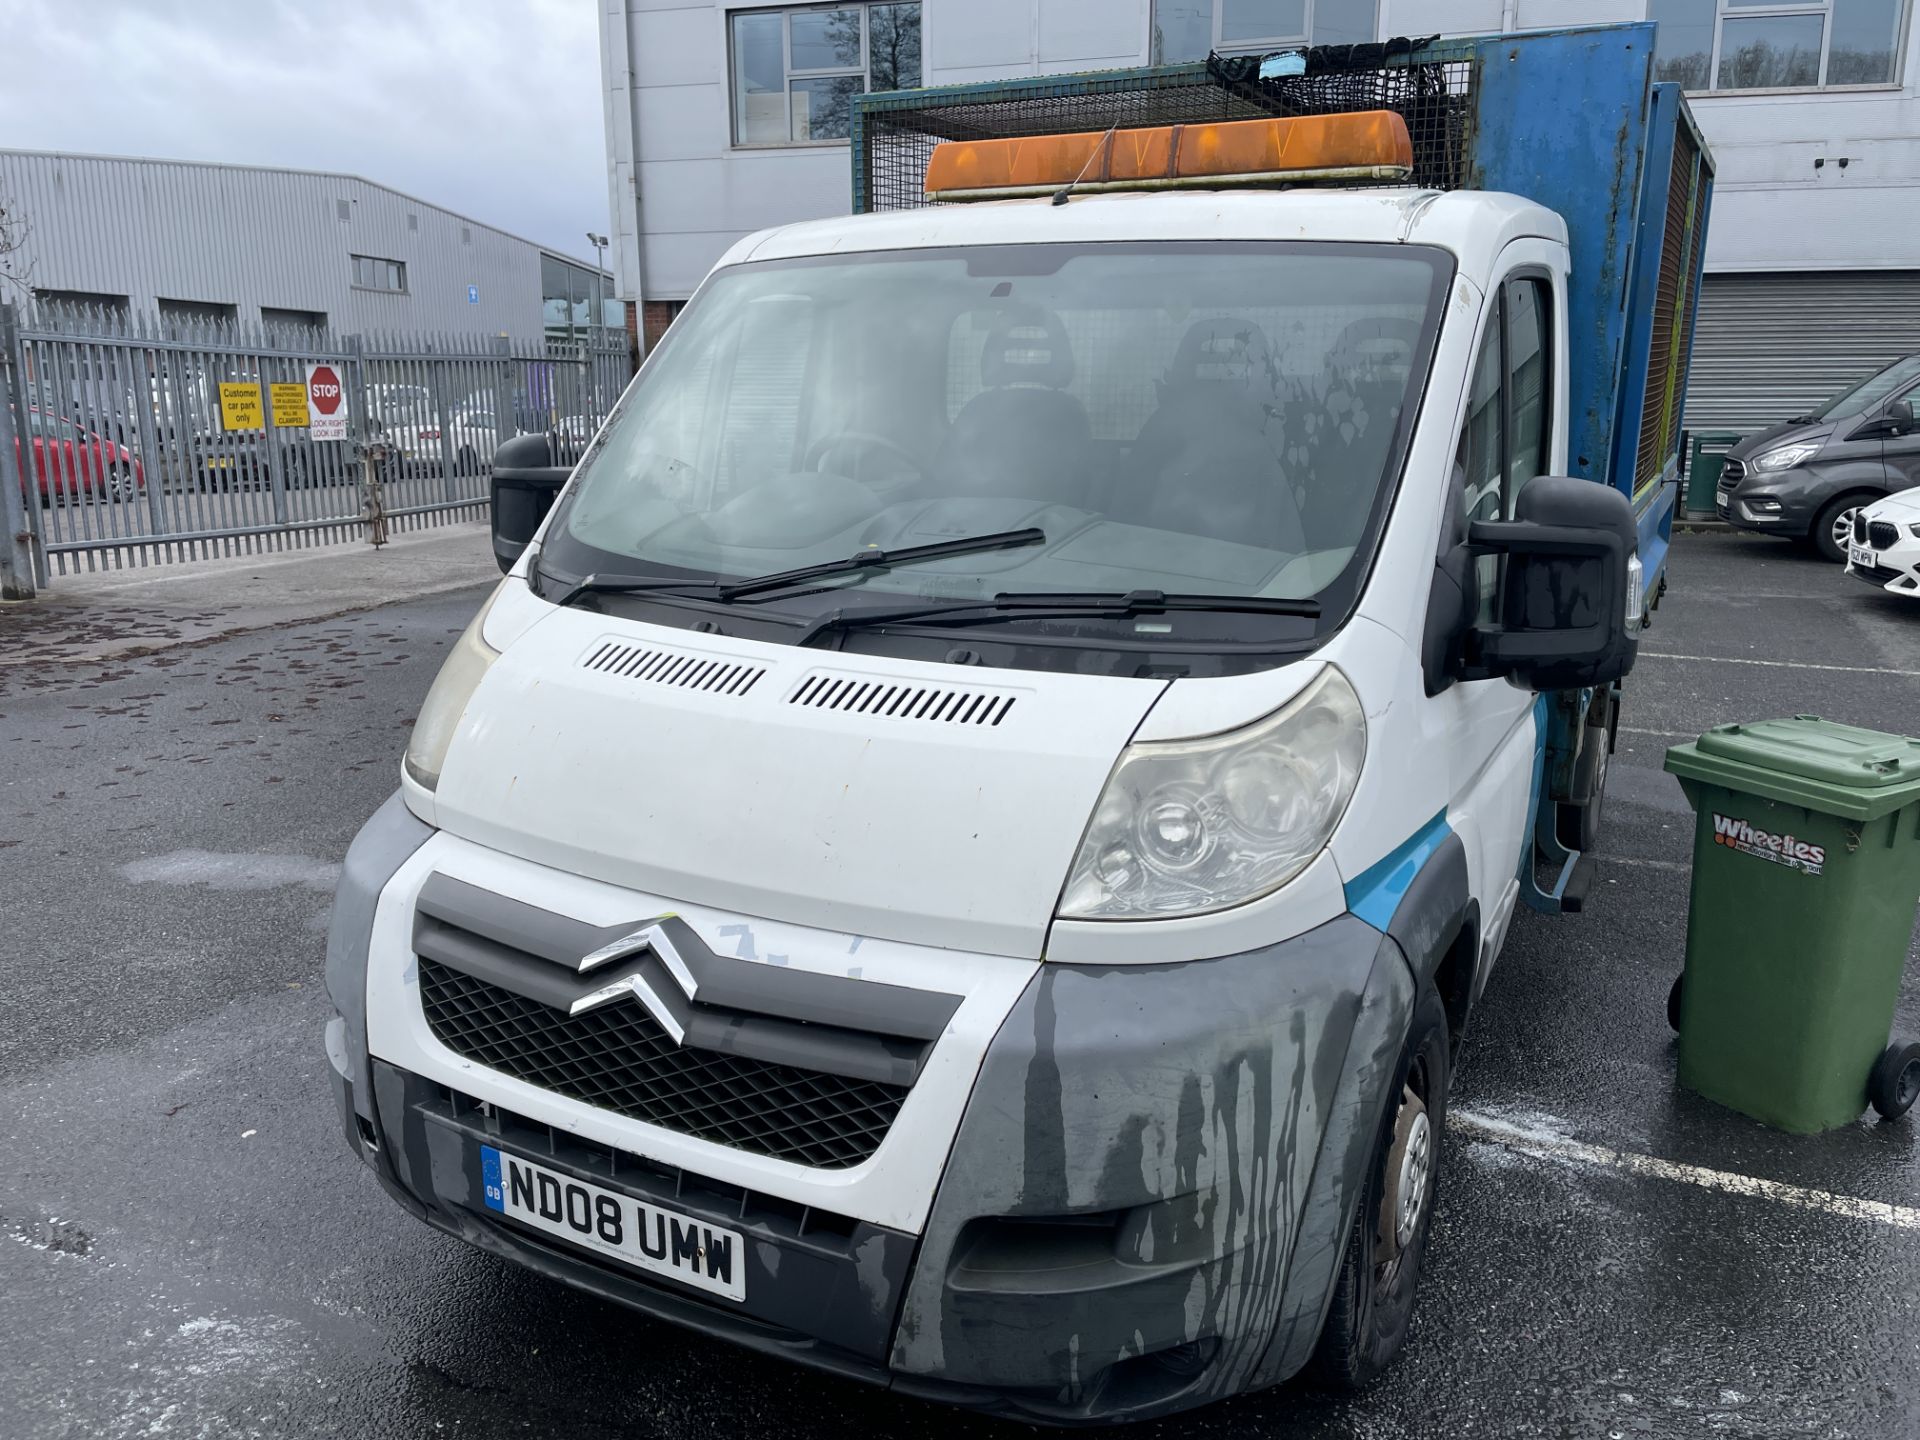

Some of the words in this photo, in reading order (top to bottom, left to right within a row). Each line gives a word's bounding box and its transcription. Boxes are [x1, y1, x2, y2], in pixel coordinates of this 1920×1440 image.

[223, 388, 257, 398] Customer
[312, 384, 339, 398] STOP
[227, 402, 238, 410] car
[240, 401, 256, 412] park
[235, 413, 250, 424] only
[312, 420, 327, 428] LOOK
[328, 420, 345, 428] RIGHT
[313, 429, 329, 437] LOOK
[330, 429, 344, 437] LEFT
[1712, 813, 1825, 865] Wheelies
[486, 1185, 501, 1201] GB
[509, 1160, 623, 1246] ND08
[637, 1206, 732, 1285] UMW
